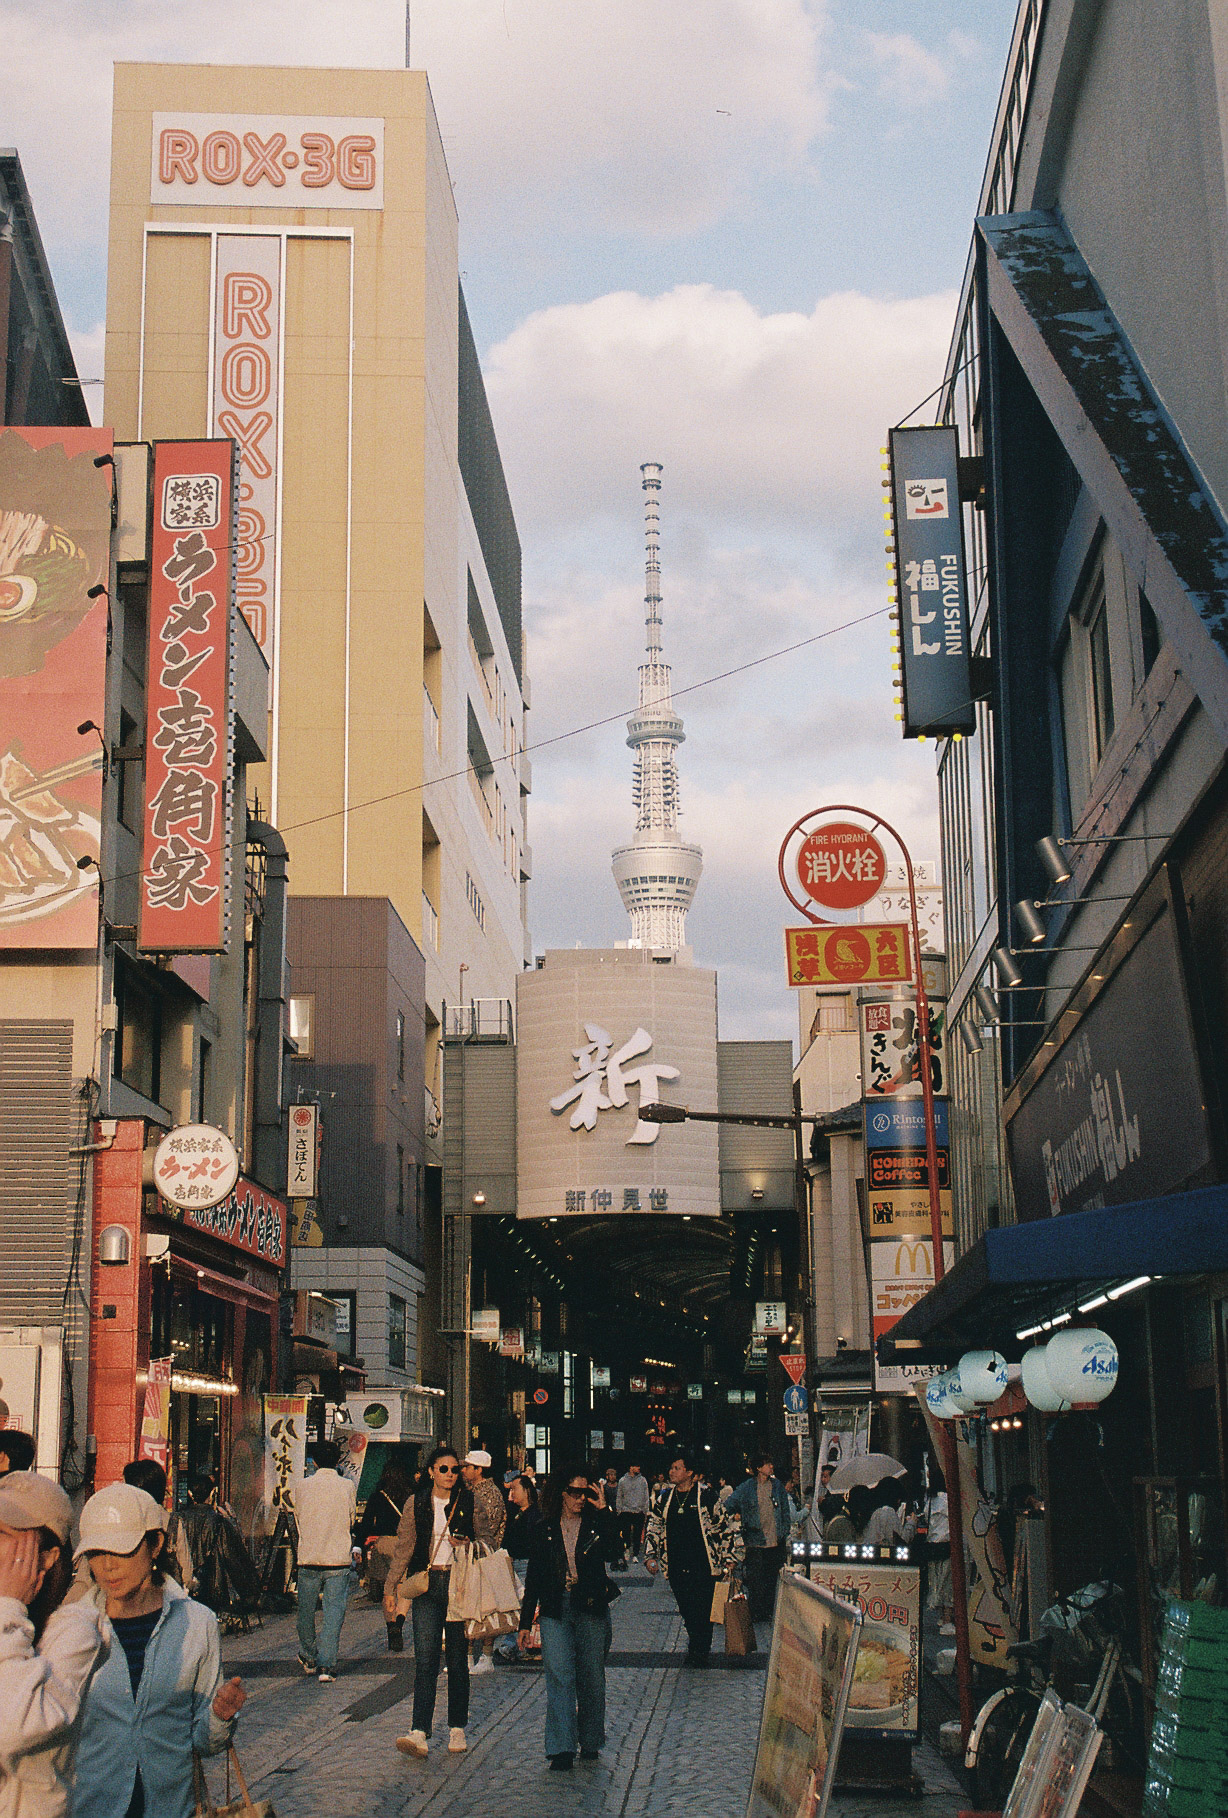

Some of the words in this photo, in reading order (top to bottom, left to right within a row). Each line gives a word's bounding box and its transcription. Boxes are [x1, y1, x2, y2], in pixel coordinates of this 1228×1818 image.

[168, 480, 215, 503] 横浜
[168, 501, 213, 525] 家系
[904, 559, 942, 657] 福しん
[940, 553, 963, 656] FUKUSHIN
[810, 835, 829, 846] FIRE
[831, 832, 869, 844] HYDRANT
[804, 848, 880, 884] 消火栓
[870, 1032, 893, 1093] きんぐ
[550, 1023, 682, 1146] 新
[169, 1137, 224, 1153] 横浜家系
[159, 1155, 233, 1180] ラーメン
[294, 1138, 308, 1183] さぼてん
[565, 1187, 669, 1212] 新仲見世
